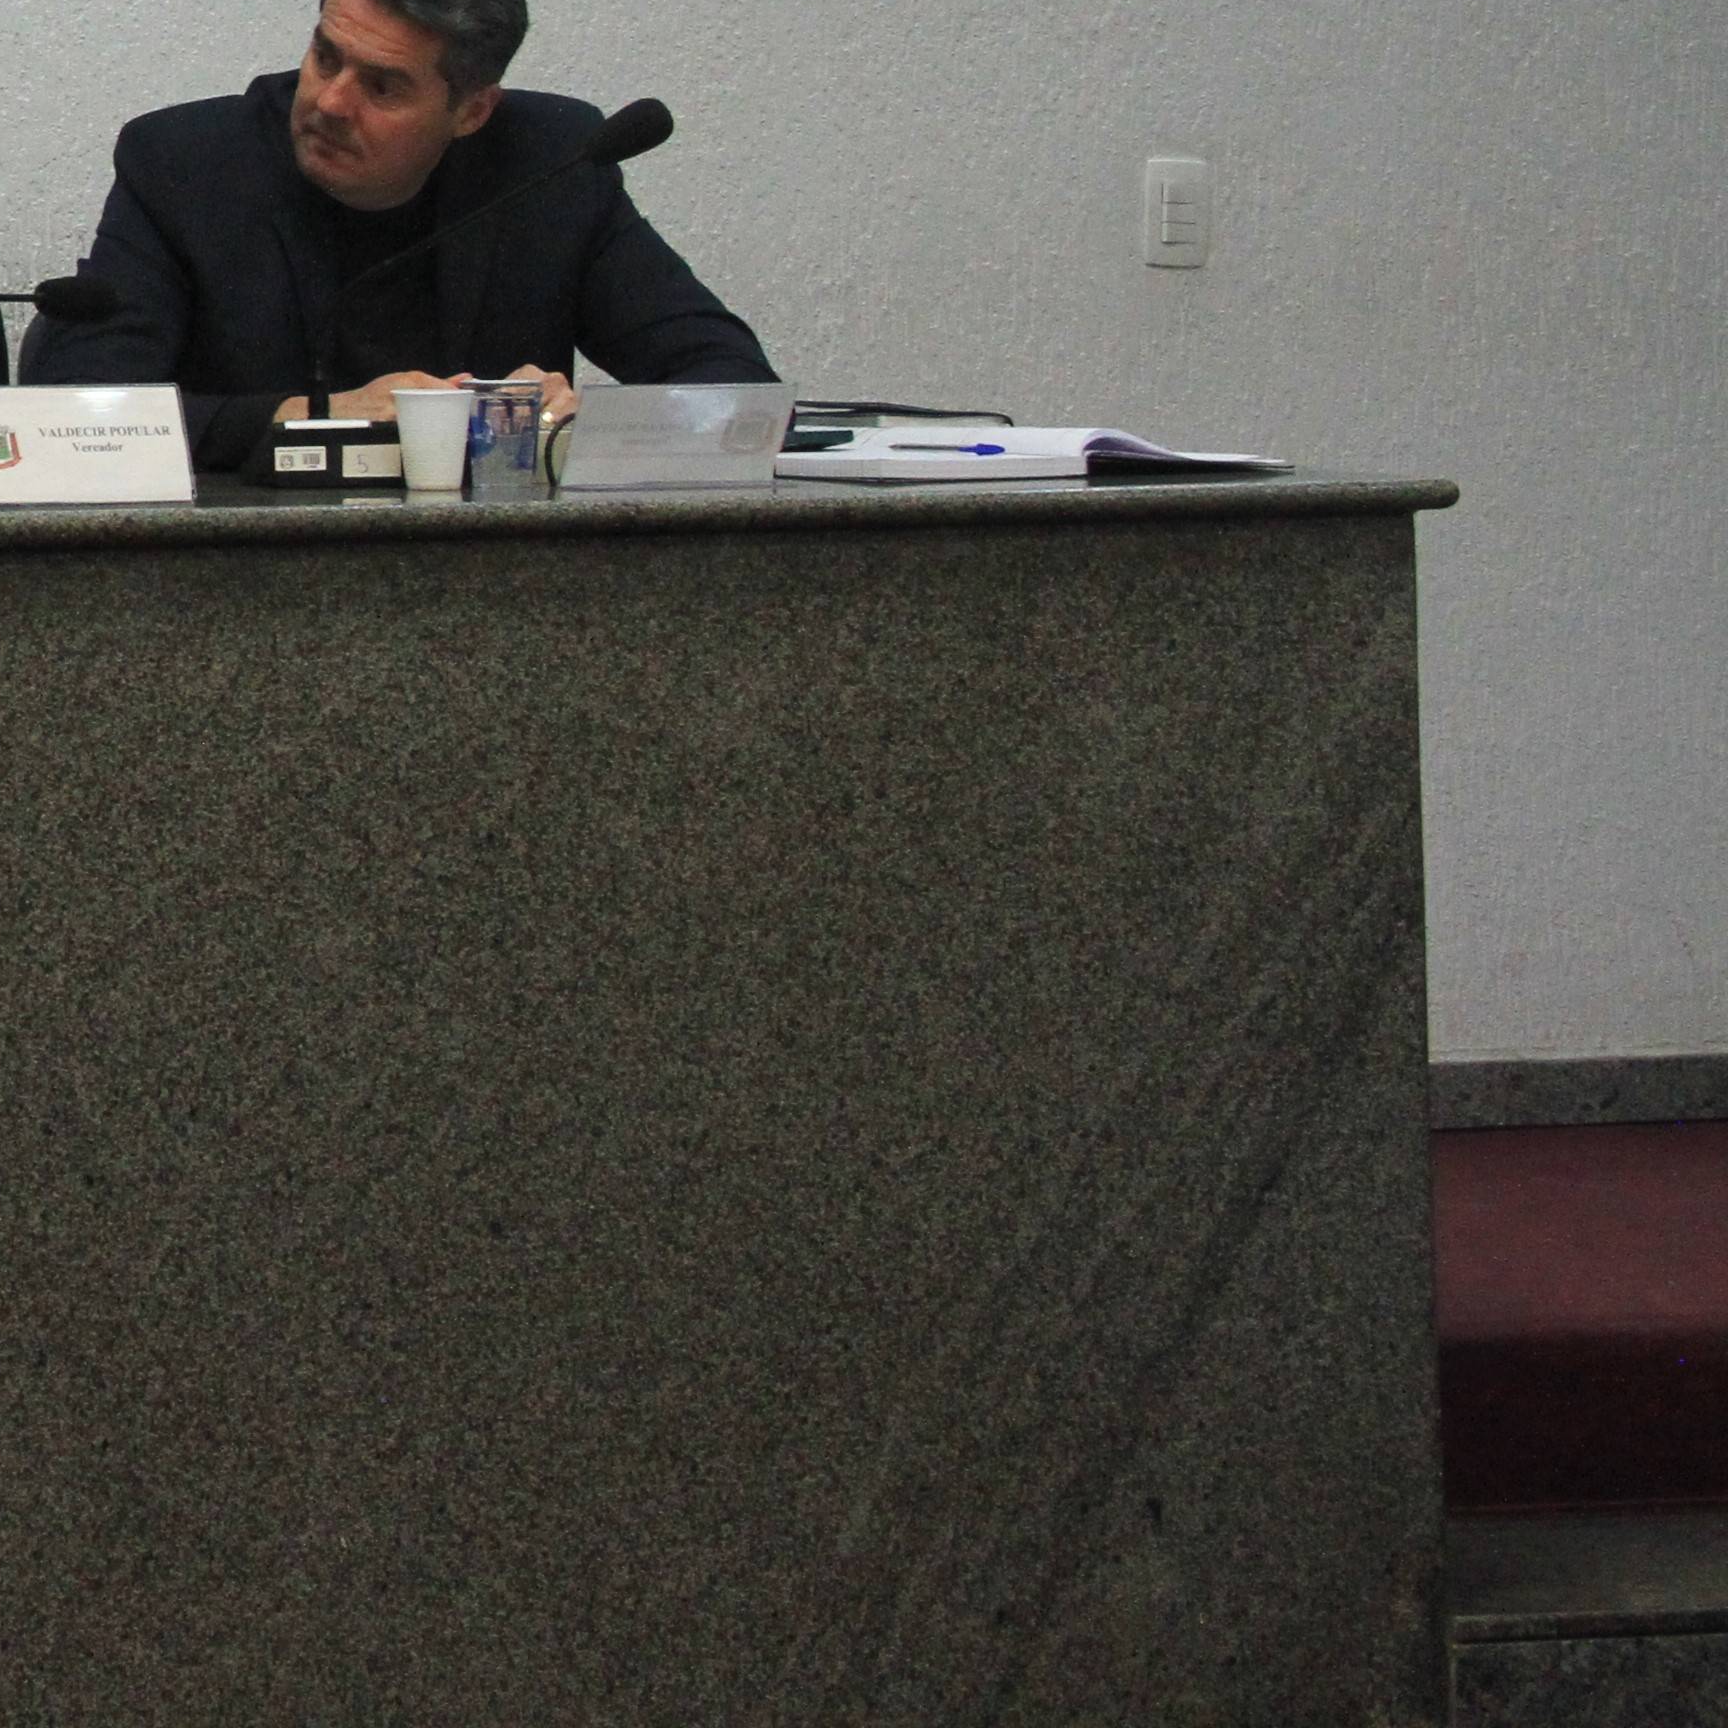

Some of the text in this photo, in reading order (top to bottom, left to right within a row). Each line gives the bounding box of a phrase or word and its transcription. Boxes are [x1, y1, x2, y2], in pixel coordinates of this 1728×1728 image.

[37, 425, 172, 439] VALDECIR POPULAR
[71, 441, 124, 453] Vereador
